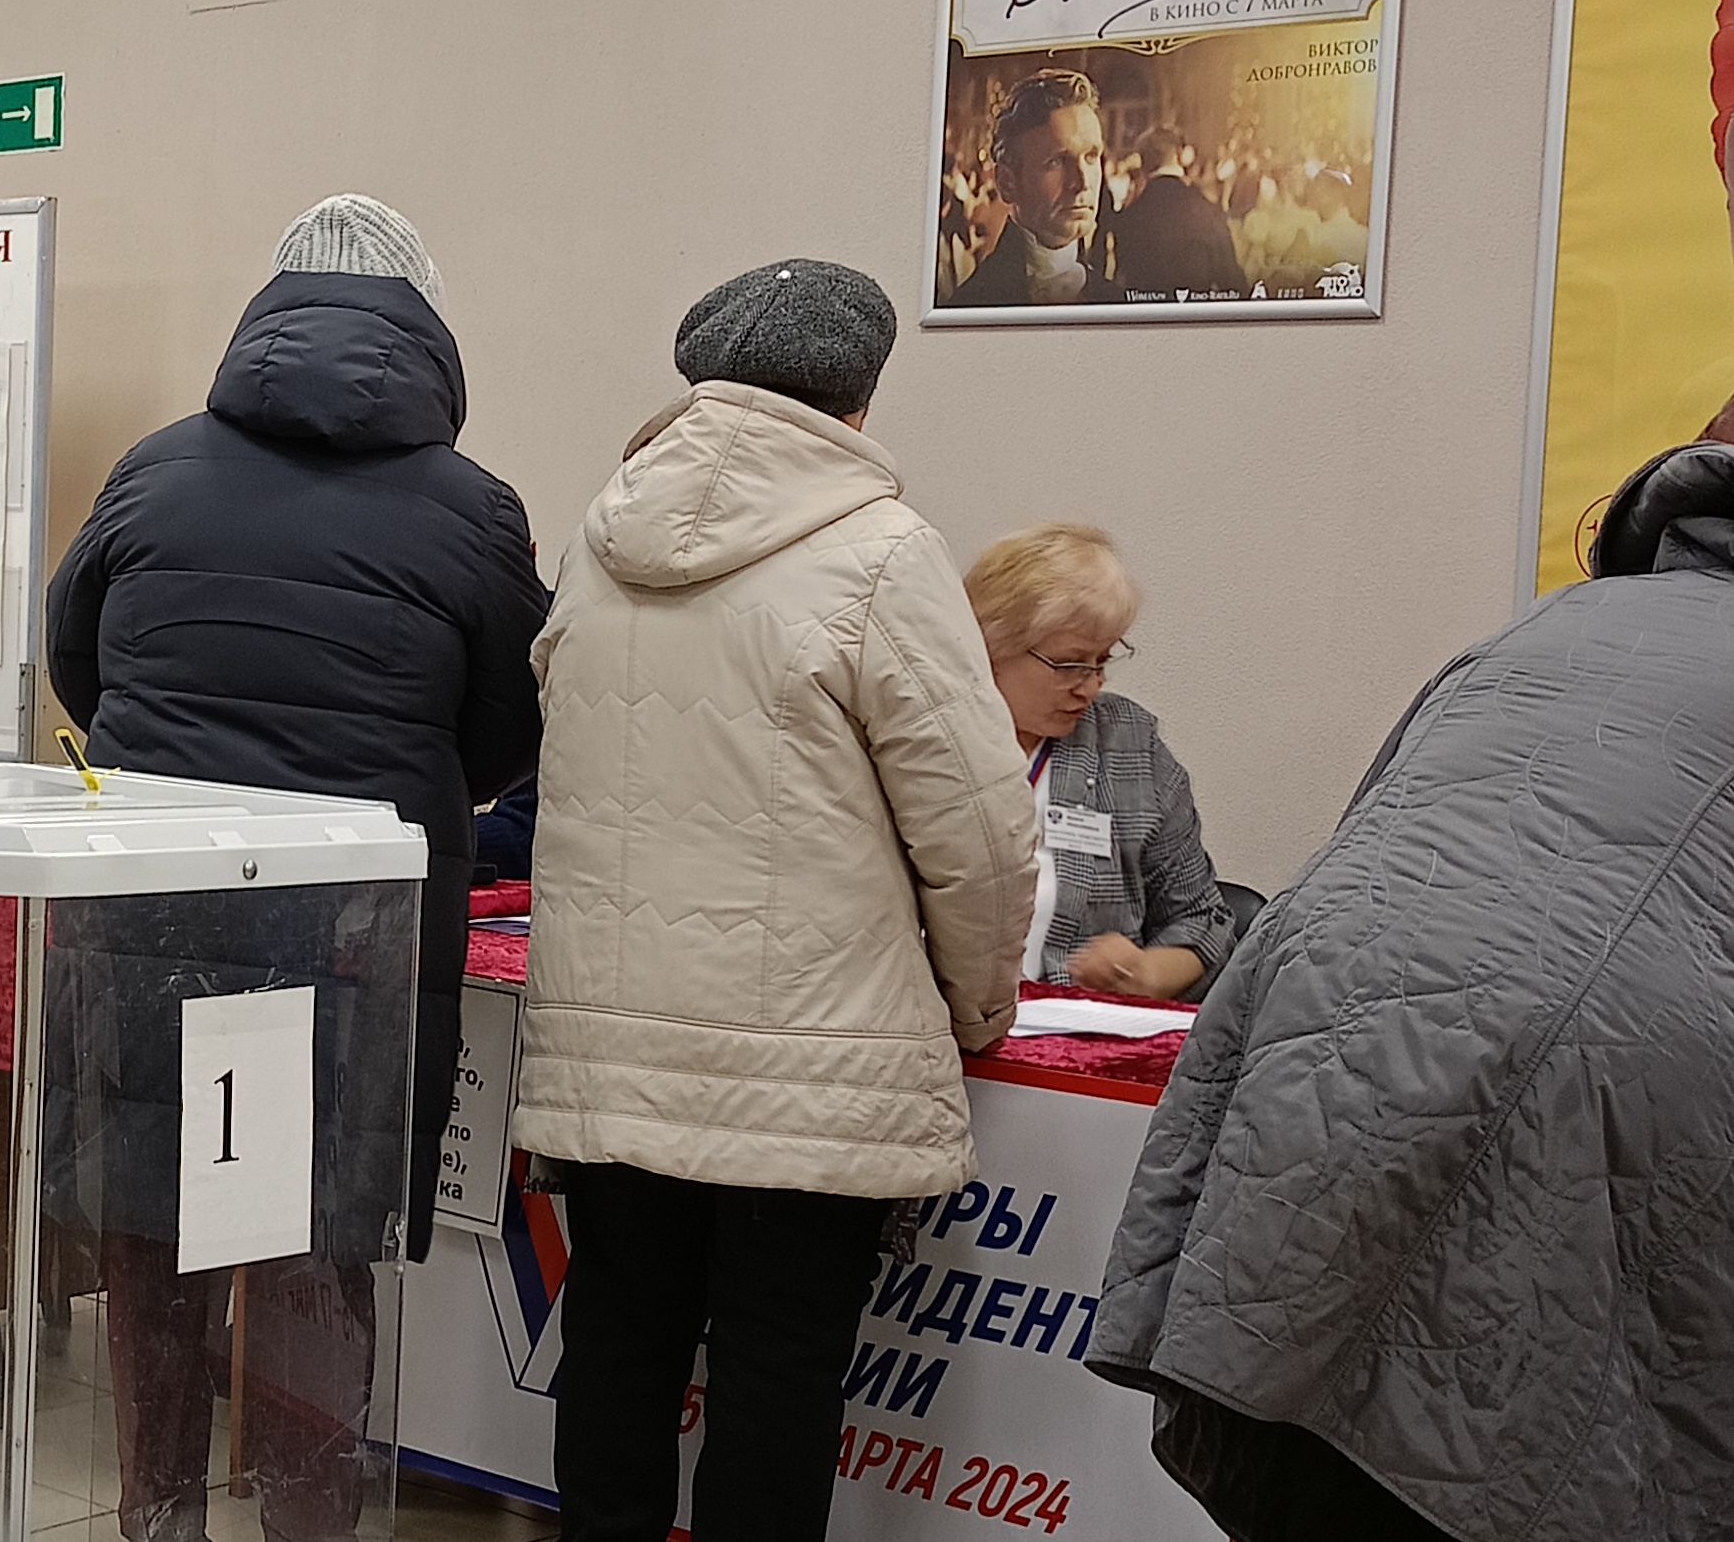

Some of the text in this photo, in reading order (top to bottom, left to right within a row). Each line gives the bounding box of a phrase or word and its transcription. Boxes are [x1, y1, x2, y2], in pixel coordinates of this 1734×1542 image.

[1149, 6, 1160, 22] В
[1165, 2, 1221, 21] КИНО
[1225, 0, 1240, 15] С
[1308, 38, 1379, 58] ВИКТОР
[1246, 58, 1377, 83] ДОБРОНРАВОВ
[213, 1068, 240, 1165] 1
[448, 1124, 471, 1141] по
[917, 1180, 1058, 1256] РЫ
[945, 1456, 1071, 1535] 2024
